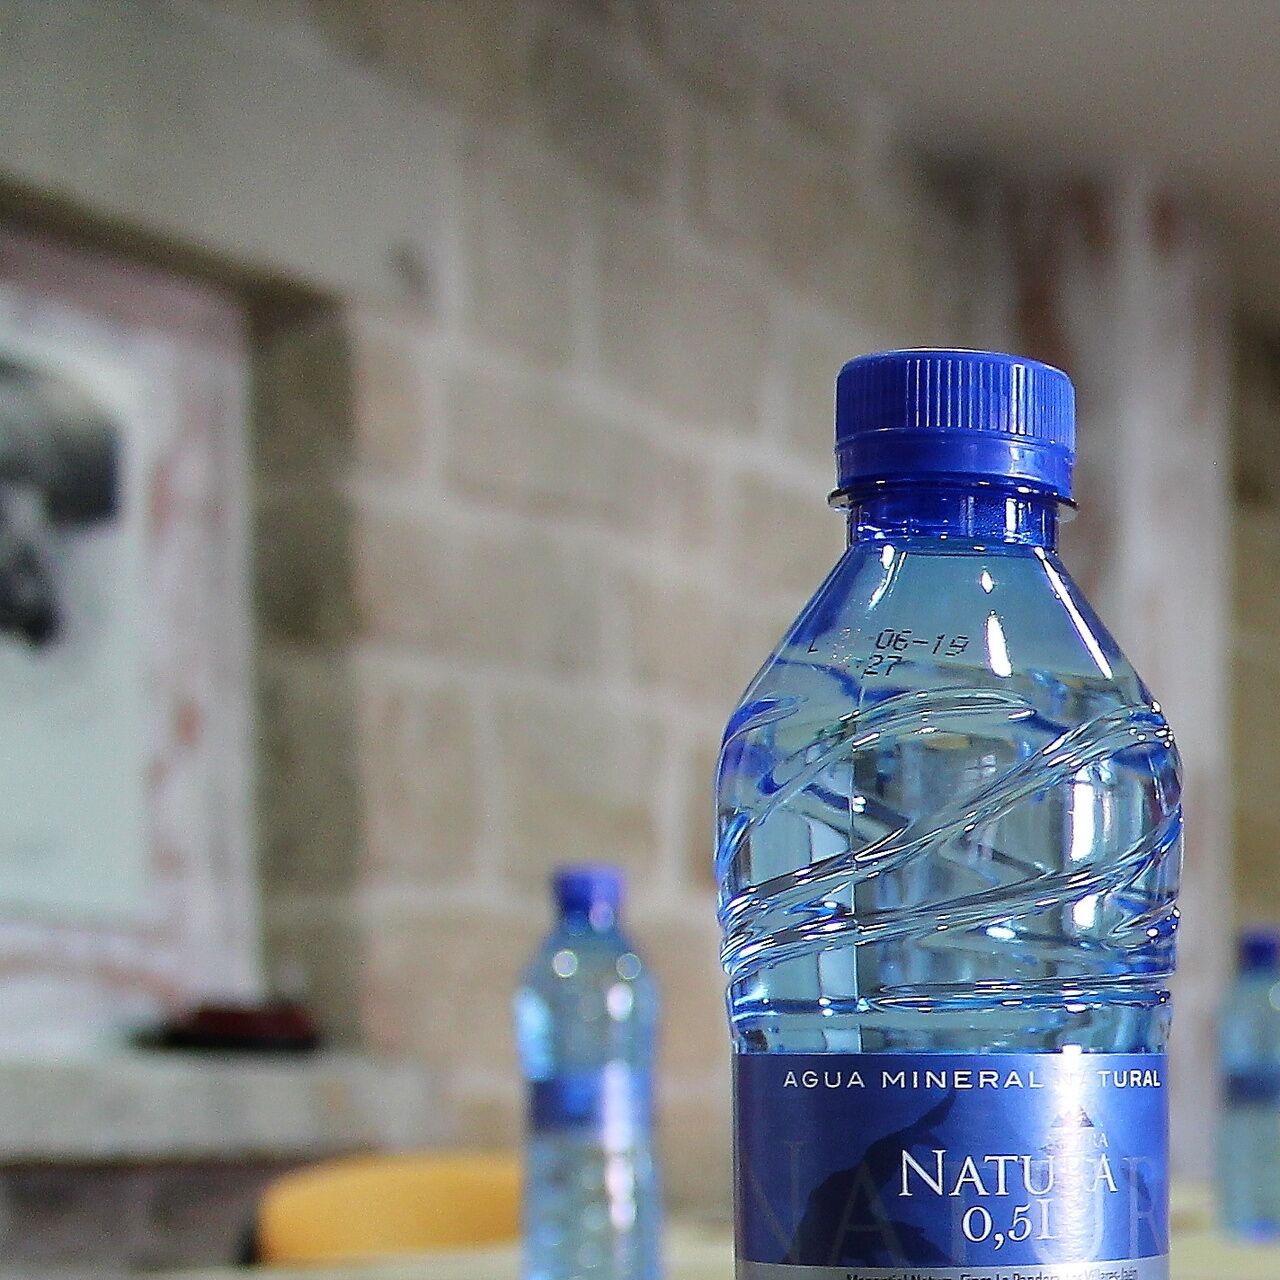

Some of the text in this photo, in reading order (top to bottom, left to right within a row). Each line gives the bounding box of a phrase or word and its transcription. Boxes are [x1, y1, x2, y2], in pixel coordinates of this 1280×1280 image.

[782, 1070, 866, 1089] AGUA
[881, 1069, 1045, 1090] MINERAL
[898, 1148, 1119, 1199] NATUA
